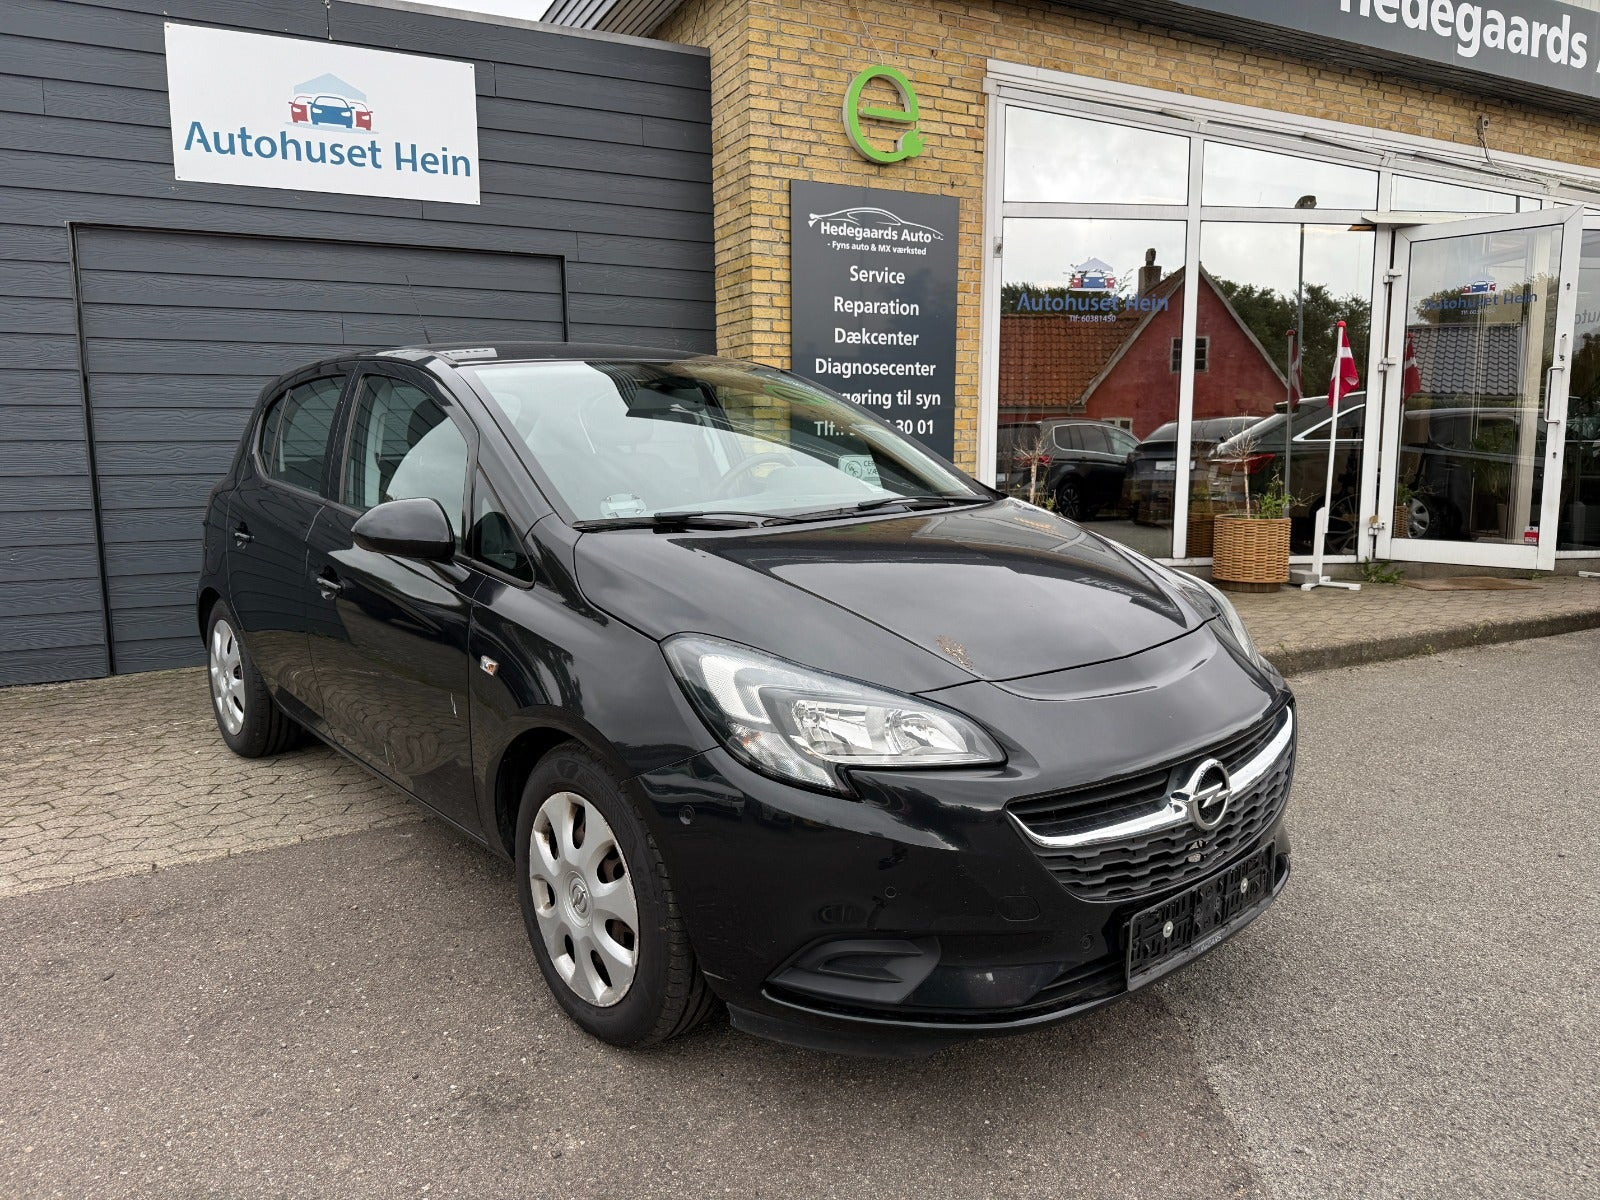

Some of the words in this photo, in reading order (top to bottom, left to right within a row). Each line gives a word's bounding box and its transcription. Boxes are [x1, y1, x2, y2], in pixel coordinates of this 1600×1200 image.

[1340, 0, 1588, 69] edegaards
[184, 121, 382, 169] Autohuset
[395, 142, 471, 177] Hein
[820, 221, 898, 240] Hedegaards
[901, 228, 932, 243] Auto
[832, 240, 850, 250] Fyns
[851, 243, 869, 251] auto
[870, 244, 877, 252] &
[878, 244, 891, 253] MX
[892, 246, 927, 255] værksted
[849, 265, 906, 285] Service
[833, 296, 920, 317] Reparation
[1017, 292, 1121, 312] Autohuset
[1126, 294, 1169, 312] Hein
[834, 328, 920, 346] Dækcenter
[815, 358, 937, 379] Diagnosecenter
[896, 389, 912, 405] til
[916, 393, 941, 410] syn
[895, 419, 914, 435] 30
[917, 419, 934, 435] 01
